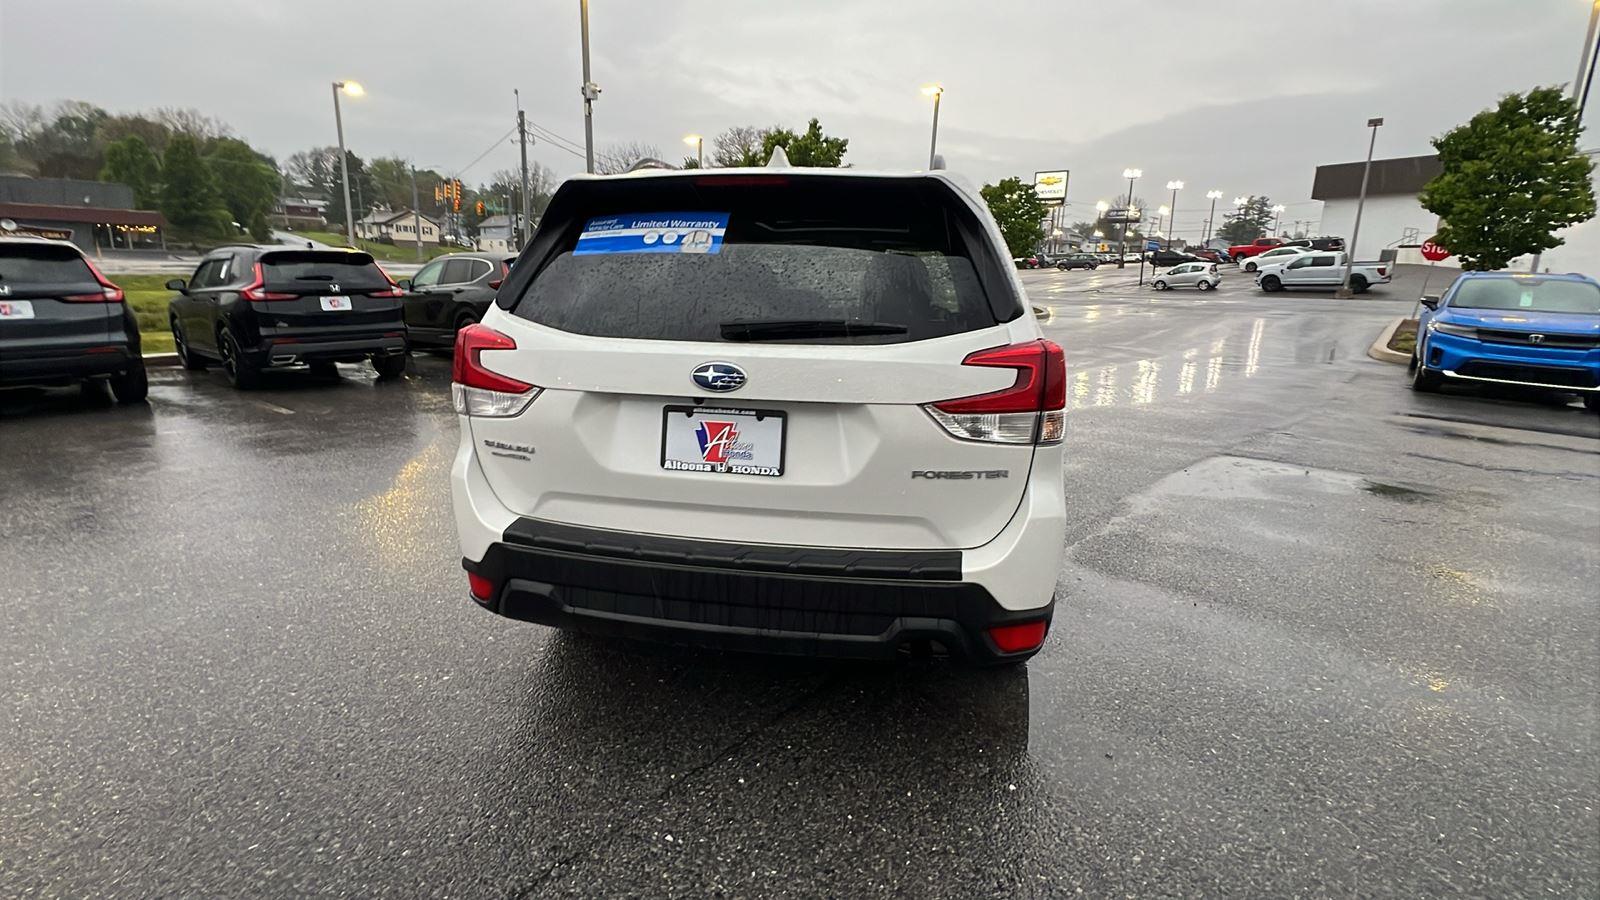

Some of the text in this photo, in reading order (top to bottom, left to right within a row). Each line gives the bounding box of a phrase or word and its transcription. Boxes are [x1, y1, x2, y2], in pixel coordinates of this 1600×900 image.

[631, 219, 720, 229] Limited Warranty
[664, 460, 712, 472] Altoona
[732, 465, 780, 476] HONDA
[911, 470, 1009, 480] FORESTER
